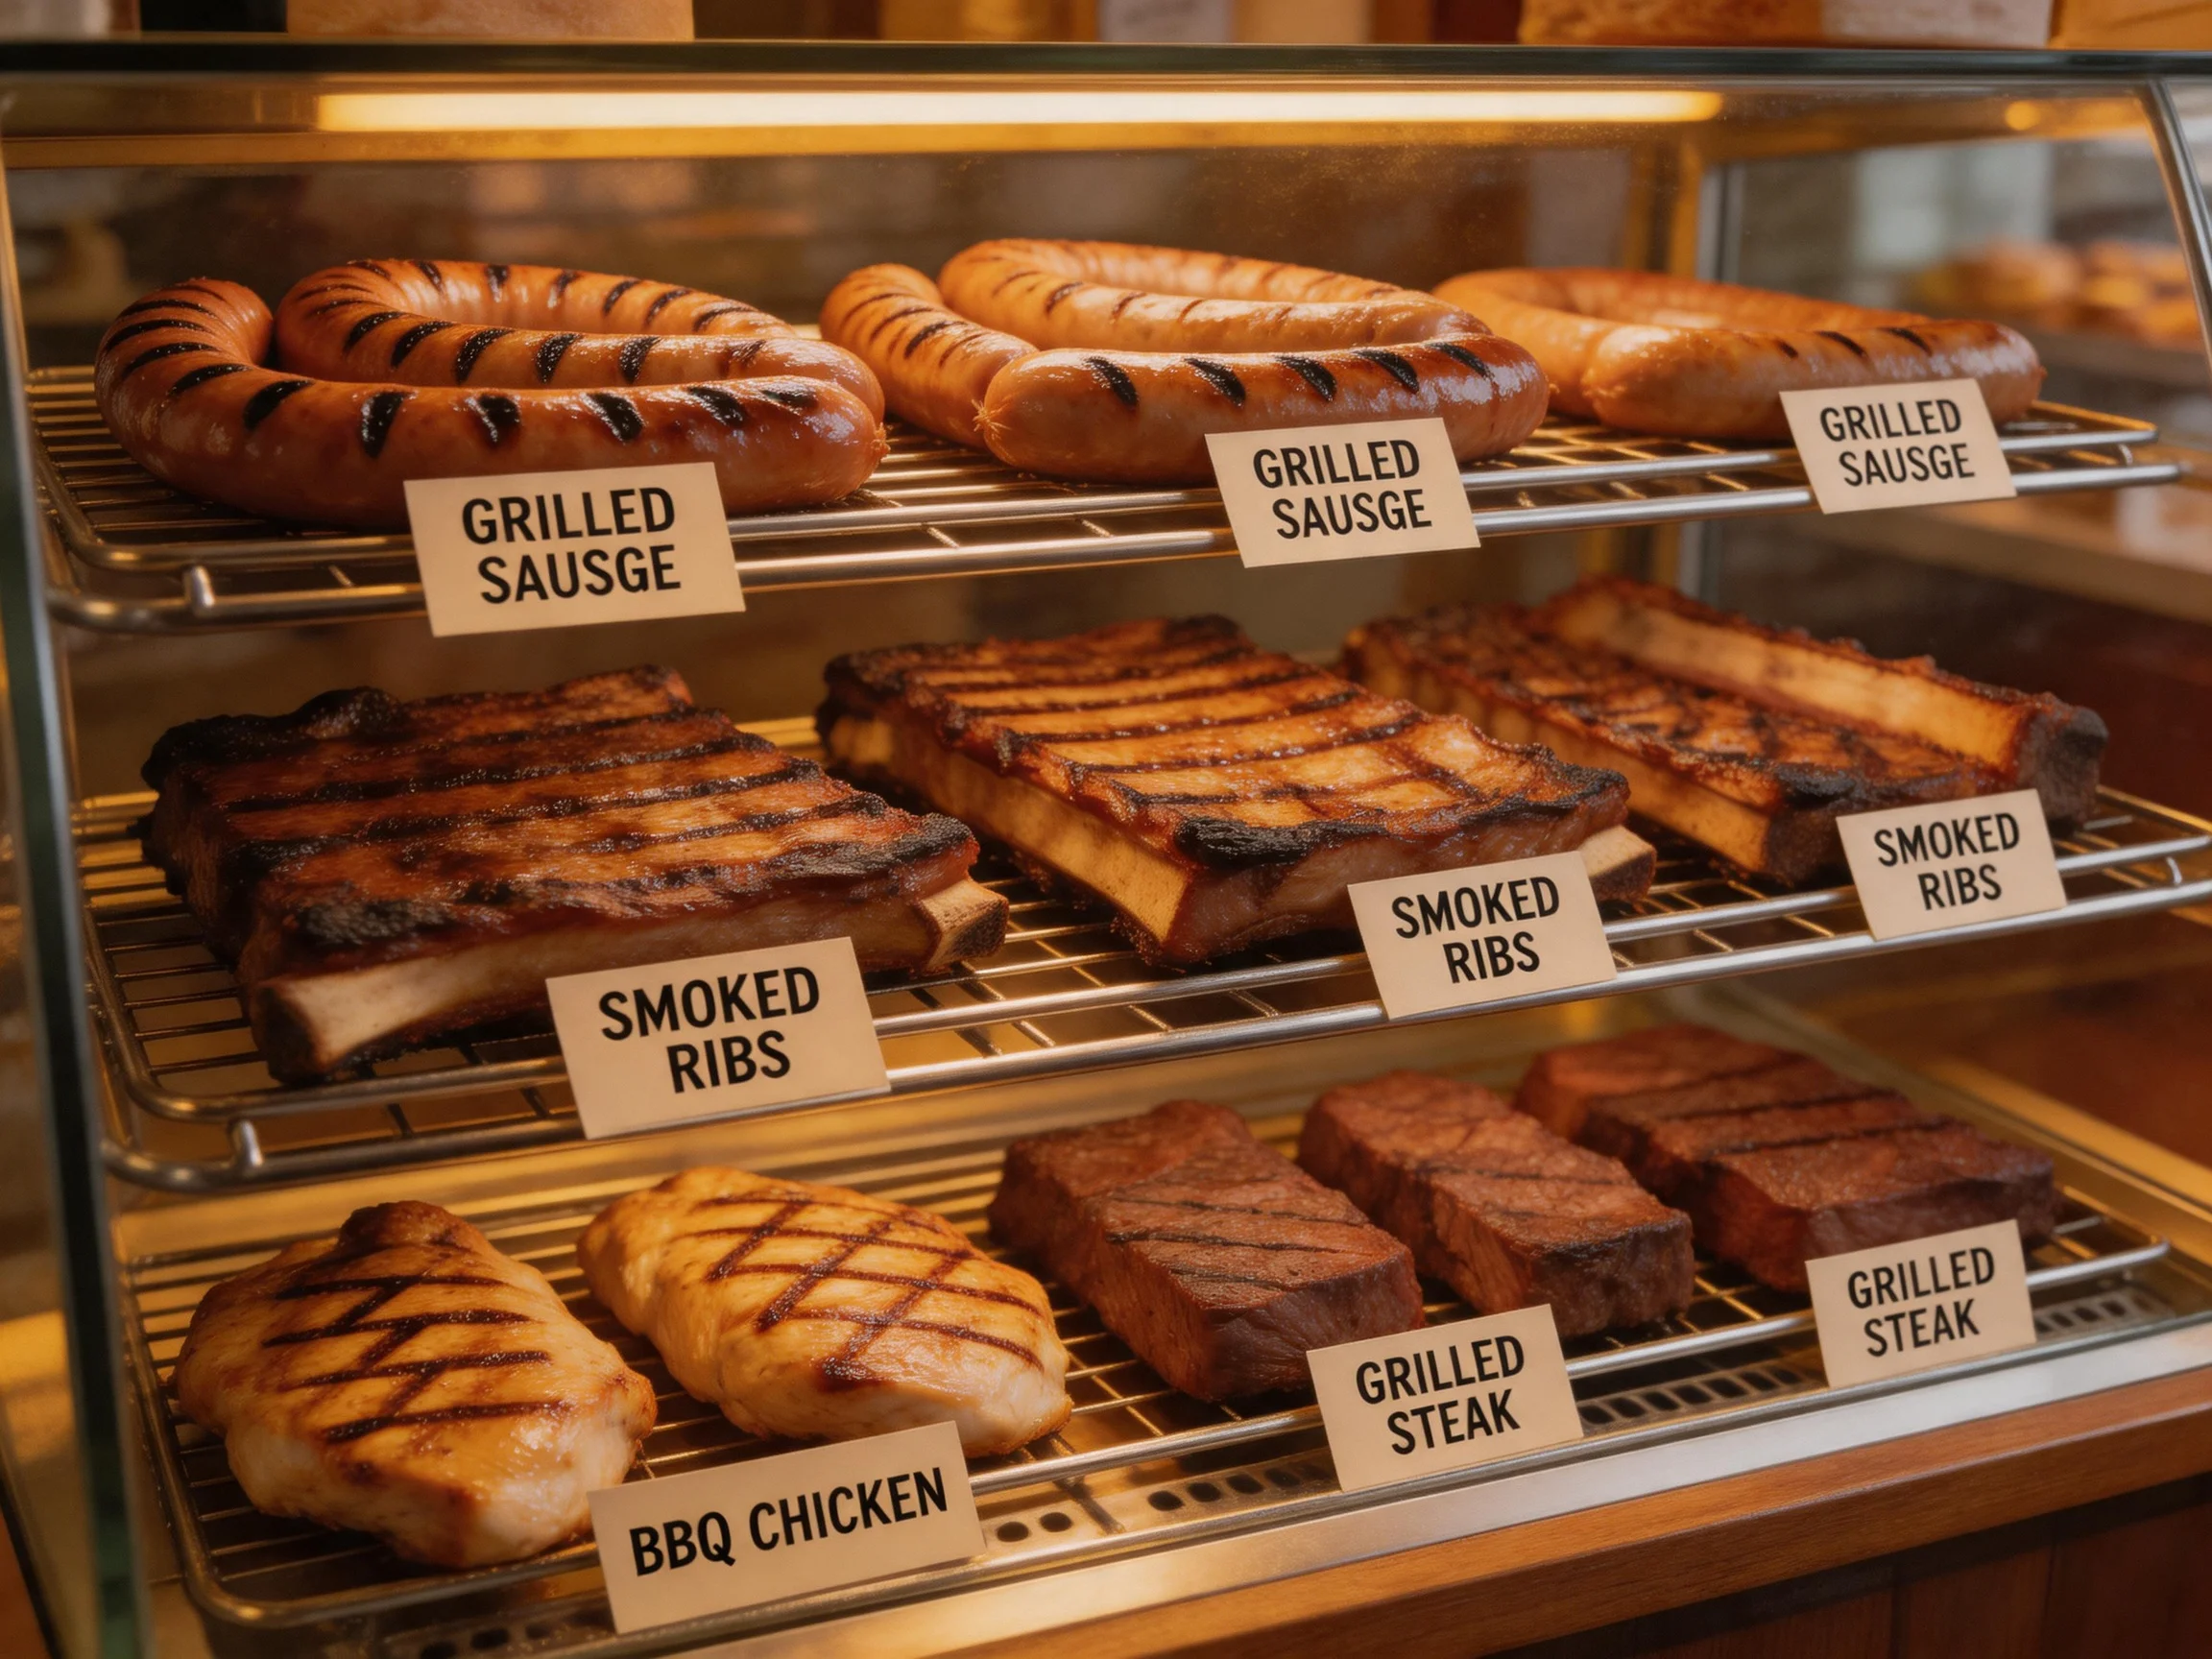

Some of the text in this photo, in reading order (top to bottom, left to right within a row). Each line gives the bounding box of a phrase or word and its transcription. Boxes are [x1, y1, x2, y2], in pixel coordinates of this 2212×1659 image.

[1820, 399, 1960, 442] GRILLED
[1254, 441, 1419, 488] GRILLED
[1839, 444, 1974, 486] SAUSGE
[462, 488, 674, 544] GRILLED
[1273, 490, 1431, 539] SAUSGE
[478, 544, 681, 604] SAUSGE
[1875, 813, 2019, 866] SMOKED
[1392, 877, 1559, 938] SMOKED
[1918, 864, 2001, 909] RIBS
[1443, 931, 1539, 983] RIBS
[599, 967, 819, 1041] SMOKED
[666, 1030, 790, 1094] RIBS
[1848, 1248, 1994, 1309] GRILLED
[1864, 1299, 1979, 1358] STEAK
[1357, 1335, 1524, 1404] GRILLED
[1387, 1389, 1520, 1455] STEAK
[629, 1467, 947, 1576] BBQ CHICKEN
